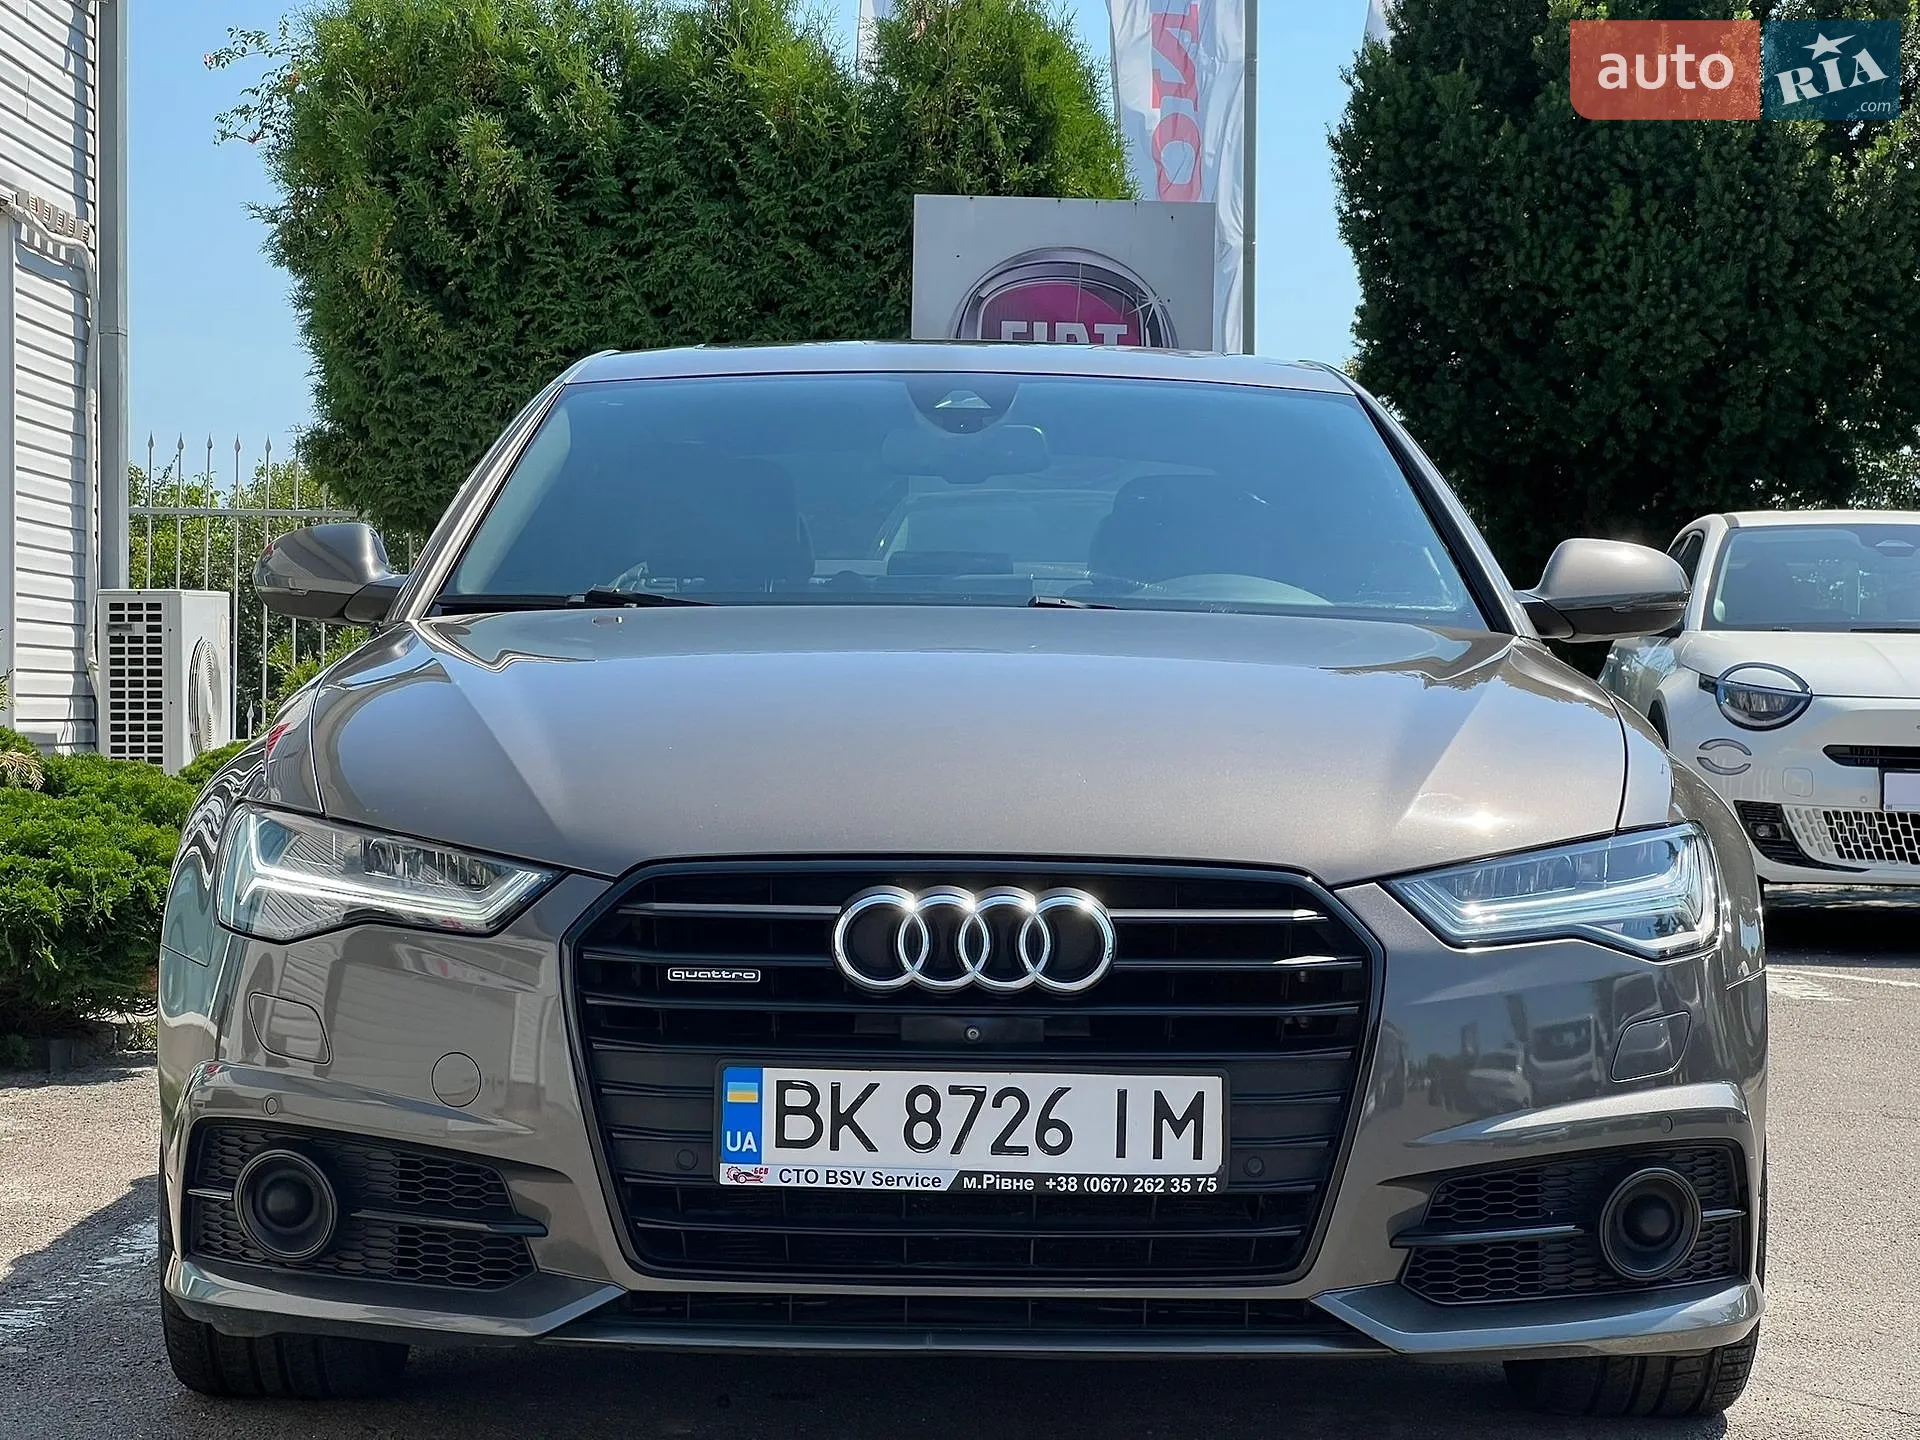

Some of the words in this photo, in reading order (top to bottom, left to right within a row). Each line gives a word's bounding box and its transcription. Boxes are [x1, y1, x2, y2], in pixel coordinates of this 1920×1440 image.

[672, 970, 756, 980] quattro
[775, 1080, 881, 1153] BK
[903, 1084, 1076, 1157] 8726
[1115, 1088, 1206, 1161] IM
[726, 1131, 757, 1153] UA
[825, 1170, 866, 1186] BSV
[872, 1172, 942, 1188] Service
[1045, 1177, 1078, 1191] +38
[1083, 1177, 1128, 1193] (067)
[1133, 1177, 1165, 1193] 262
[1170, 1178, 1191, 1193] 35
[1196, 1177, 1218, 1192] 75
